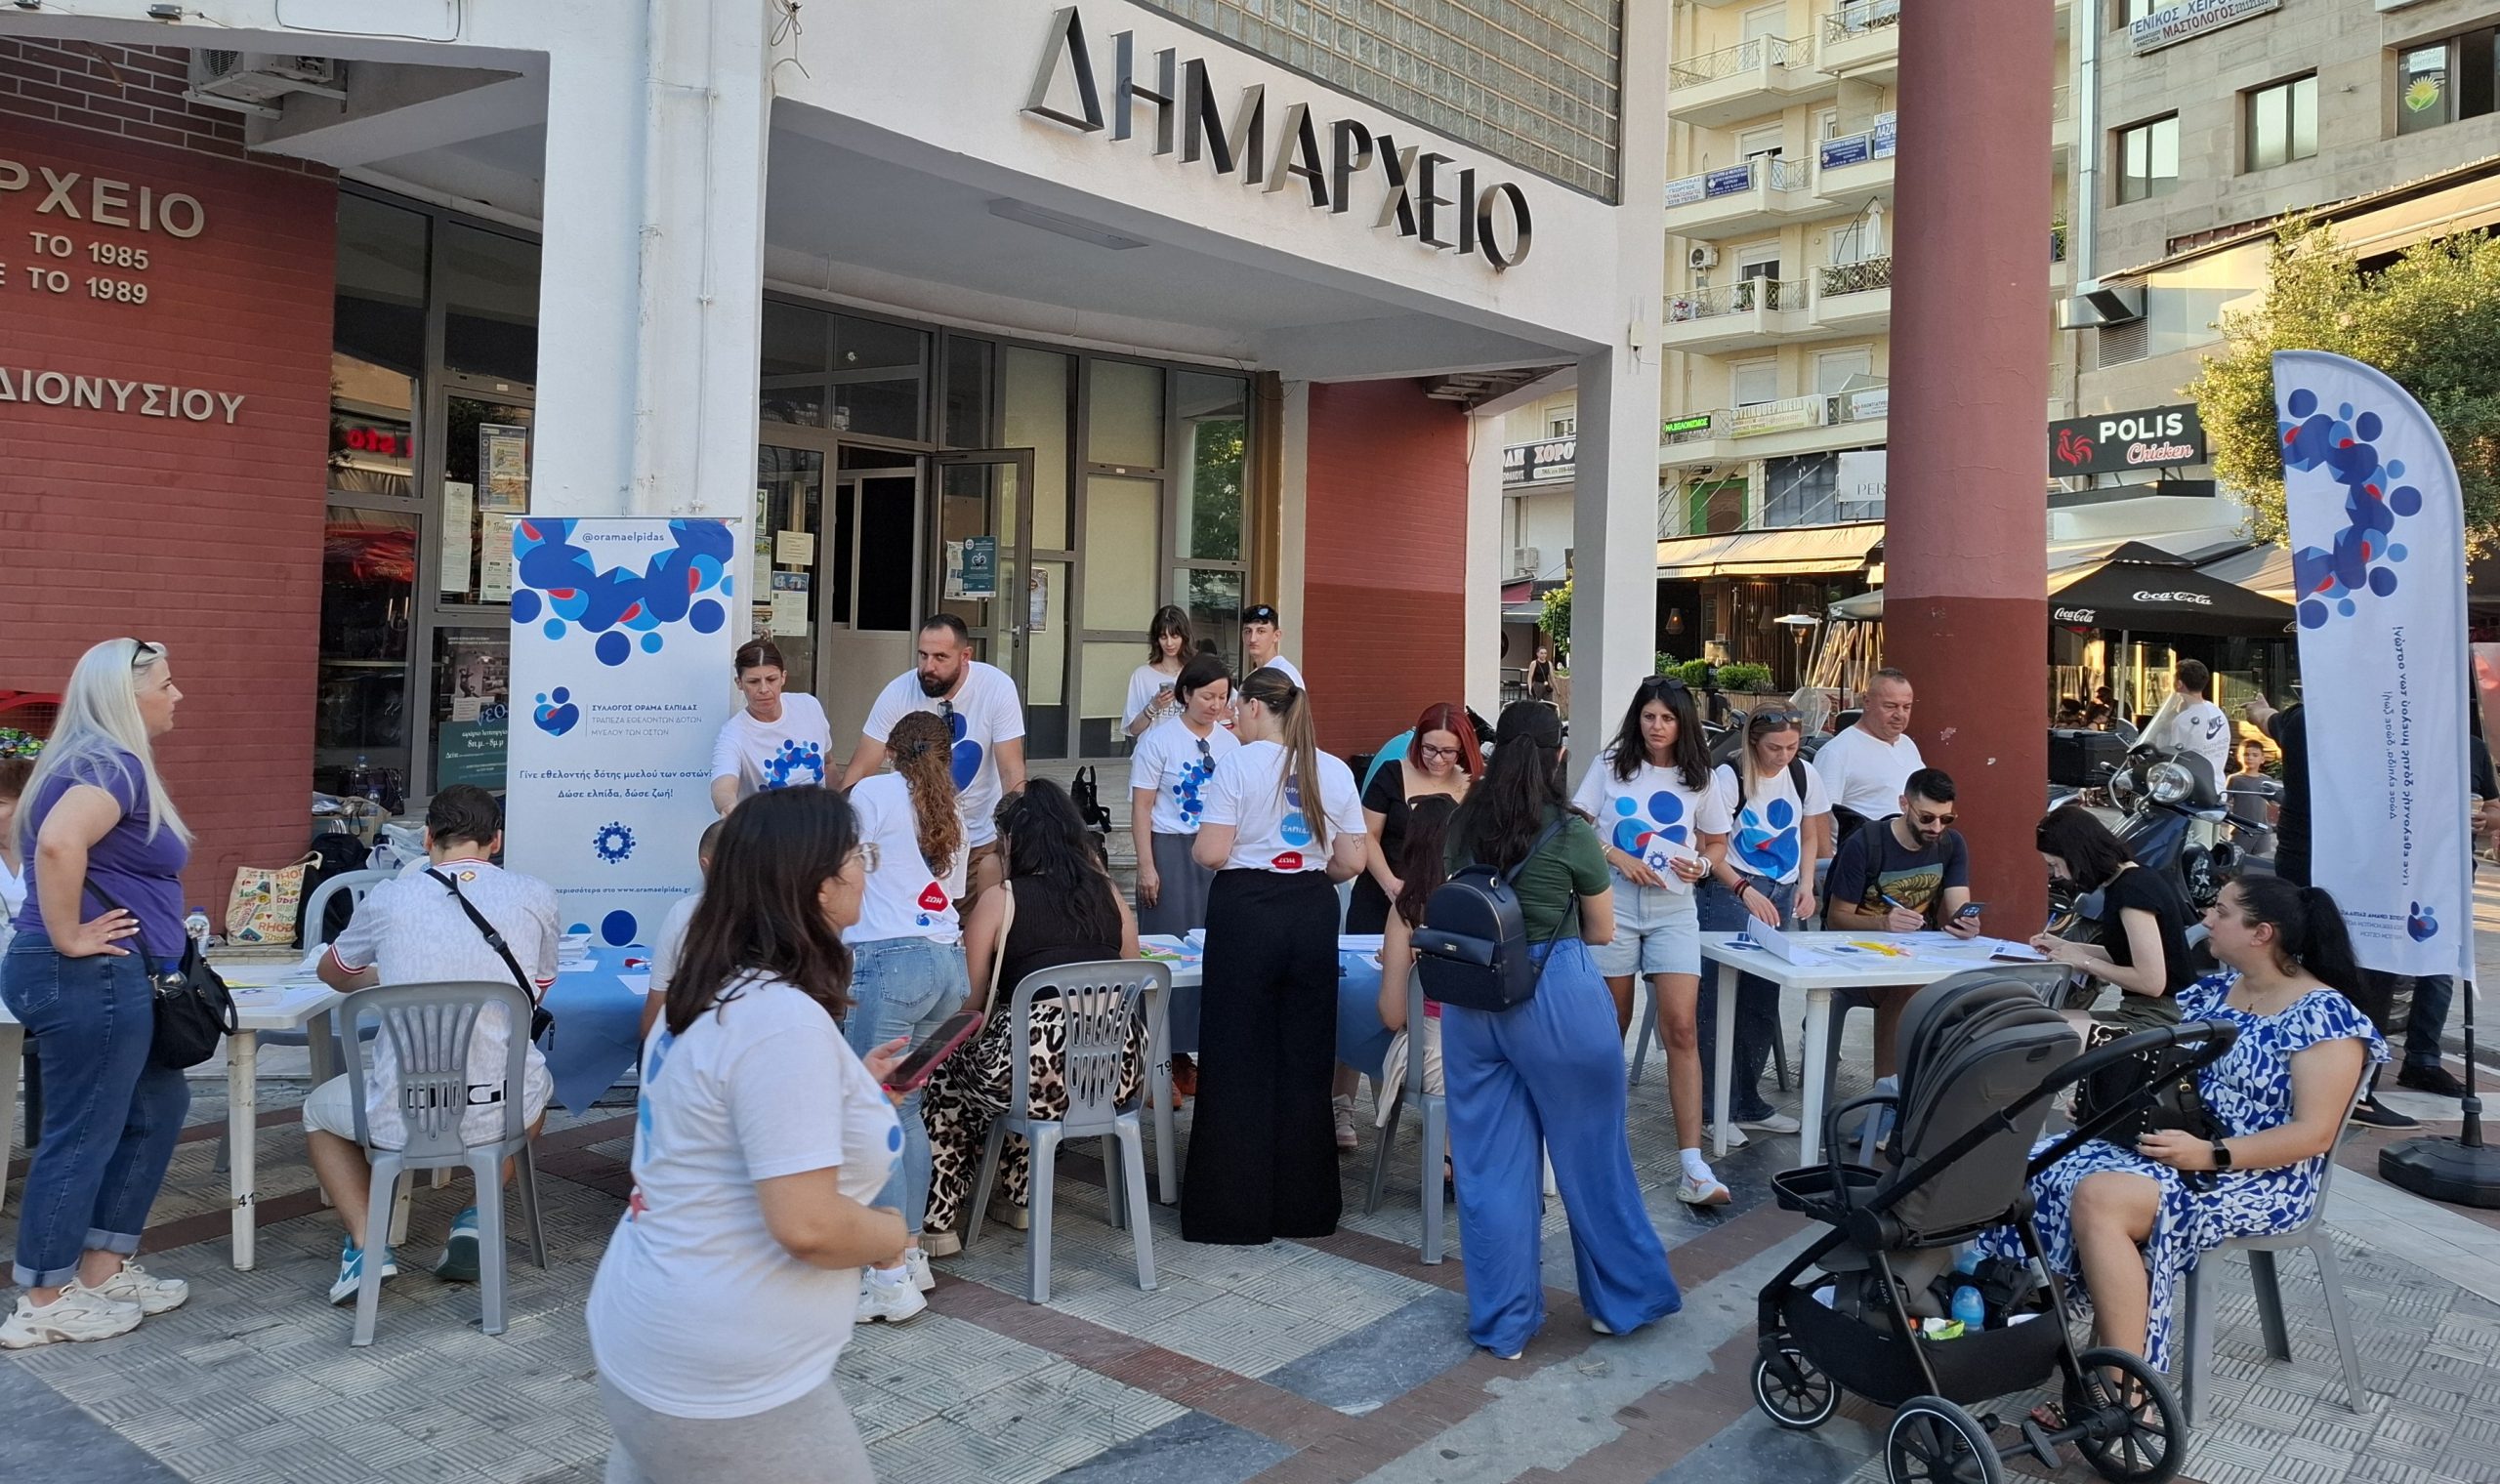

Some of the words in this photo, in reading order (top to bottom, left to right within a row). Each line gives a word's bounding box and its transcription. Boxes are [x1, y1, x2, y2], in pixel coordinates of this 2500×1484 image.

[2130, 7, 2180, 36] ΓΕΝΙΚΟΣ
[2187, 0, 2233, 16] ΧΕΙΡ
[2161, 4, 2236, 40] ΜΑΣΤΟΛΟΓΟΣ
[1017, 5, 1533, 268] ΔΗΜΑΡΧΕΙΟ
[1876, 122, 1896, 138] ΛΑΖΑ
[29, 231, 72, 258] ΤΟ
[88, 241, 148, 270] 1985
[26, 267, 70, 293] ΤΟ
[86, 276, 148, 305] 1989
[0, 367, 244, 424] ΔΙΟΝΥΣΙΟΥ
[2100, 413, 2184, 444] POLIS
[1534, 441, 1576, 464] ΧΟΡΟ
[2127, 441, 2194, 465] Chicken
[582, 531, 664, 543] @oramaelpidas
[520, 769, 538, 779] Γίνε
[541, 769, 591, 780] εθελοντής
[593, 769, 621, 780] δότης
[623, 769, 658, 780] μυελού
[680, 769, 712, 778] οστών!
[558, 789, 585, 798] Δώσε
[587, 789, 622, 799] ελπίδα,
[624, 789, 649, 798] δώσε
[651, 789, 674, 799] ζωή!
[617, 886, 691, 894] www.oramaelpidas.gr
[1156, 1060, 1172, 1076] 79
[238, 1191, 255, 1207] 41
